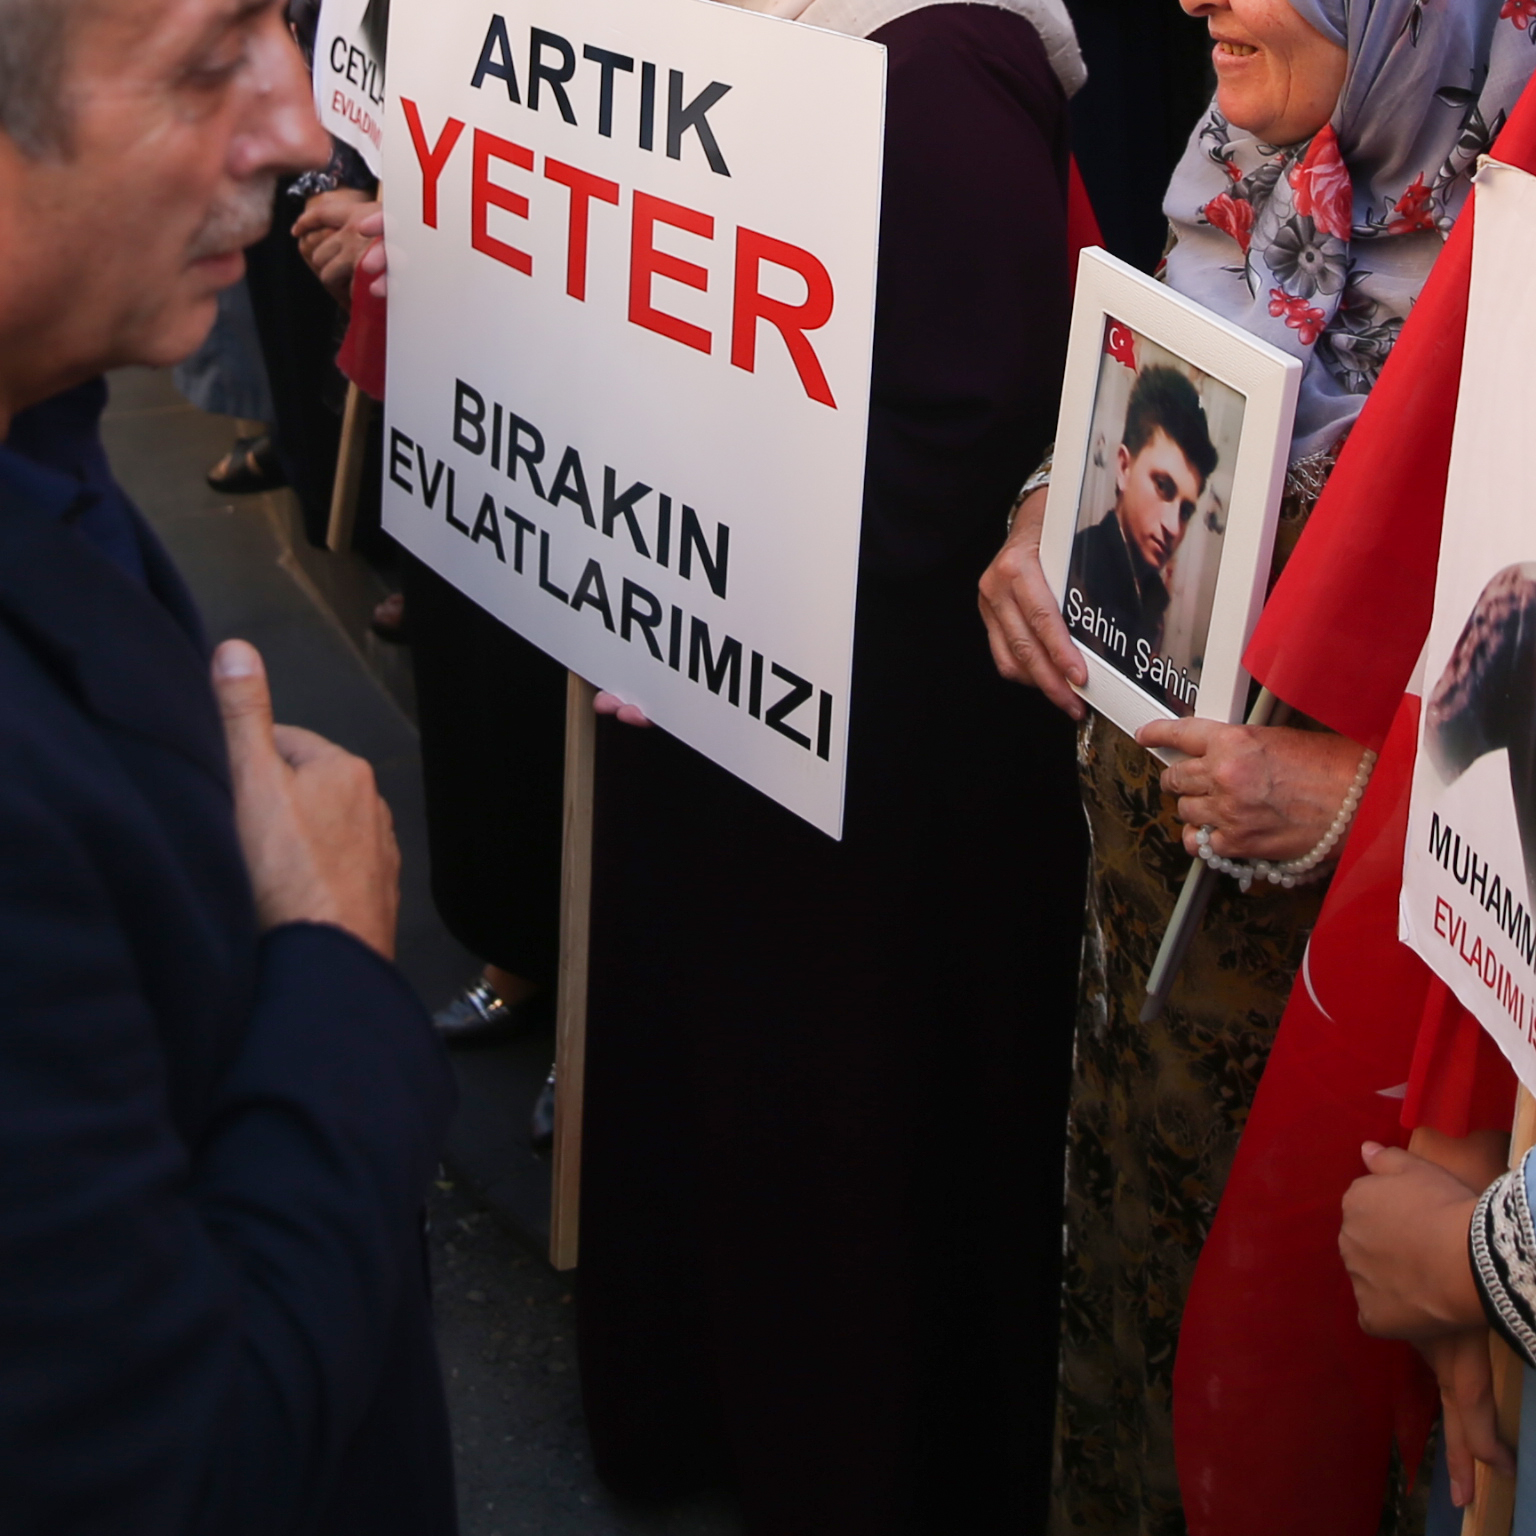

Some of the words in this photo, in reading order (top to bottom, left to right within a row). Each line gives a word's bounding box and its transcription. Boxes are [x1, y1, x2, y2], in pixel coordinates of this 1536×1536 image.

[470, 13, 732, 178] ARTIK
[400, 96, 838, 410] YETER
[453, 378, 731, 600] BIRAKIN
[389, 427, 833, 762] EVLATLARIMIZI
[1066, 587, 1127, 657] Şahin
[1133, 638, 1200, 704] Şahin
[1433, 895, 1525, 1030] EVLADIMI
